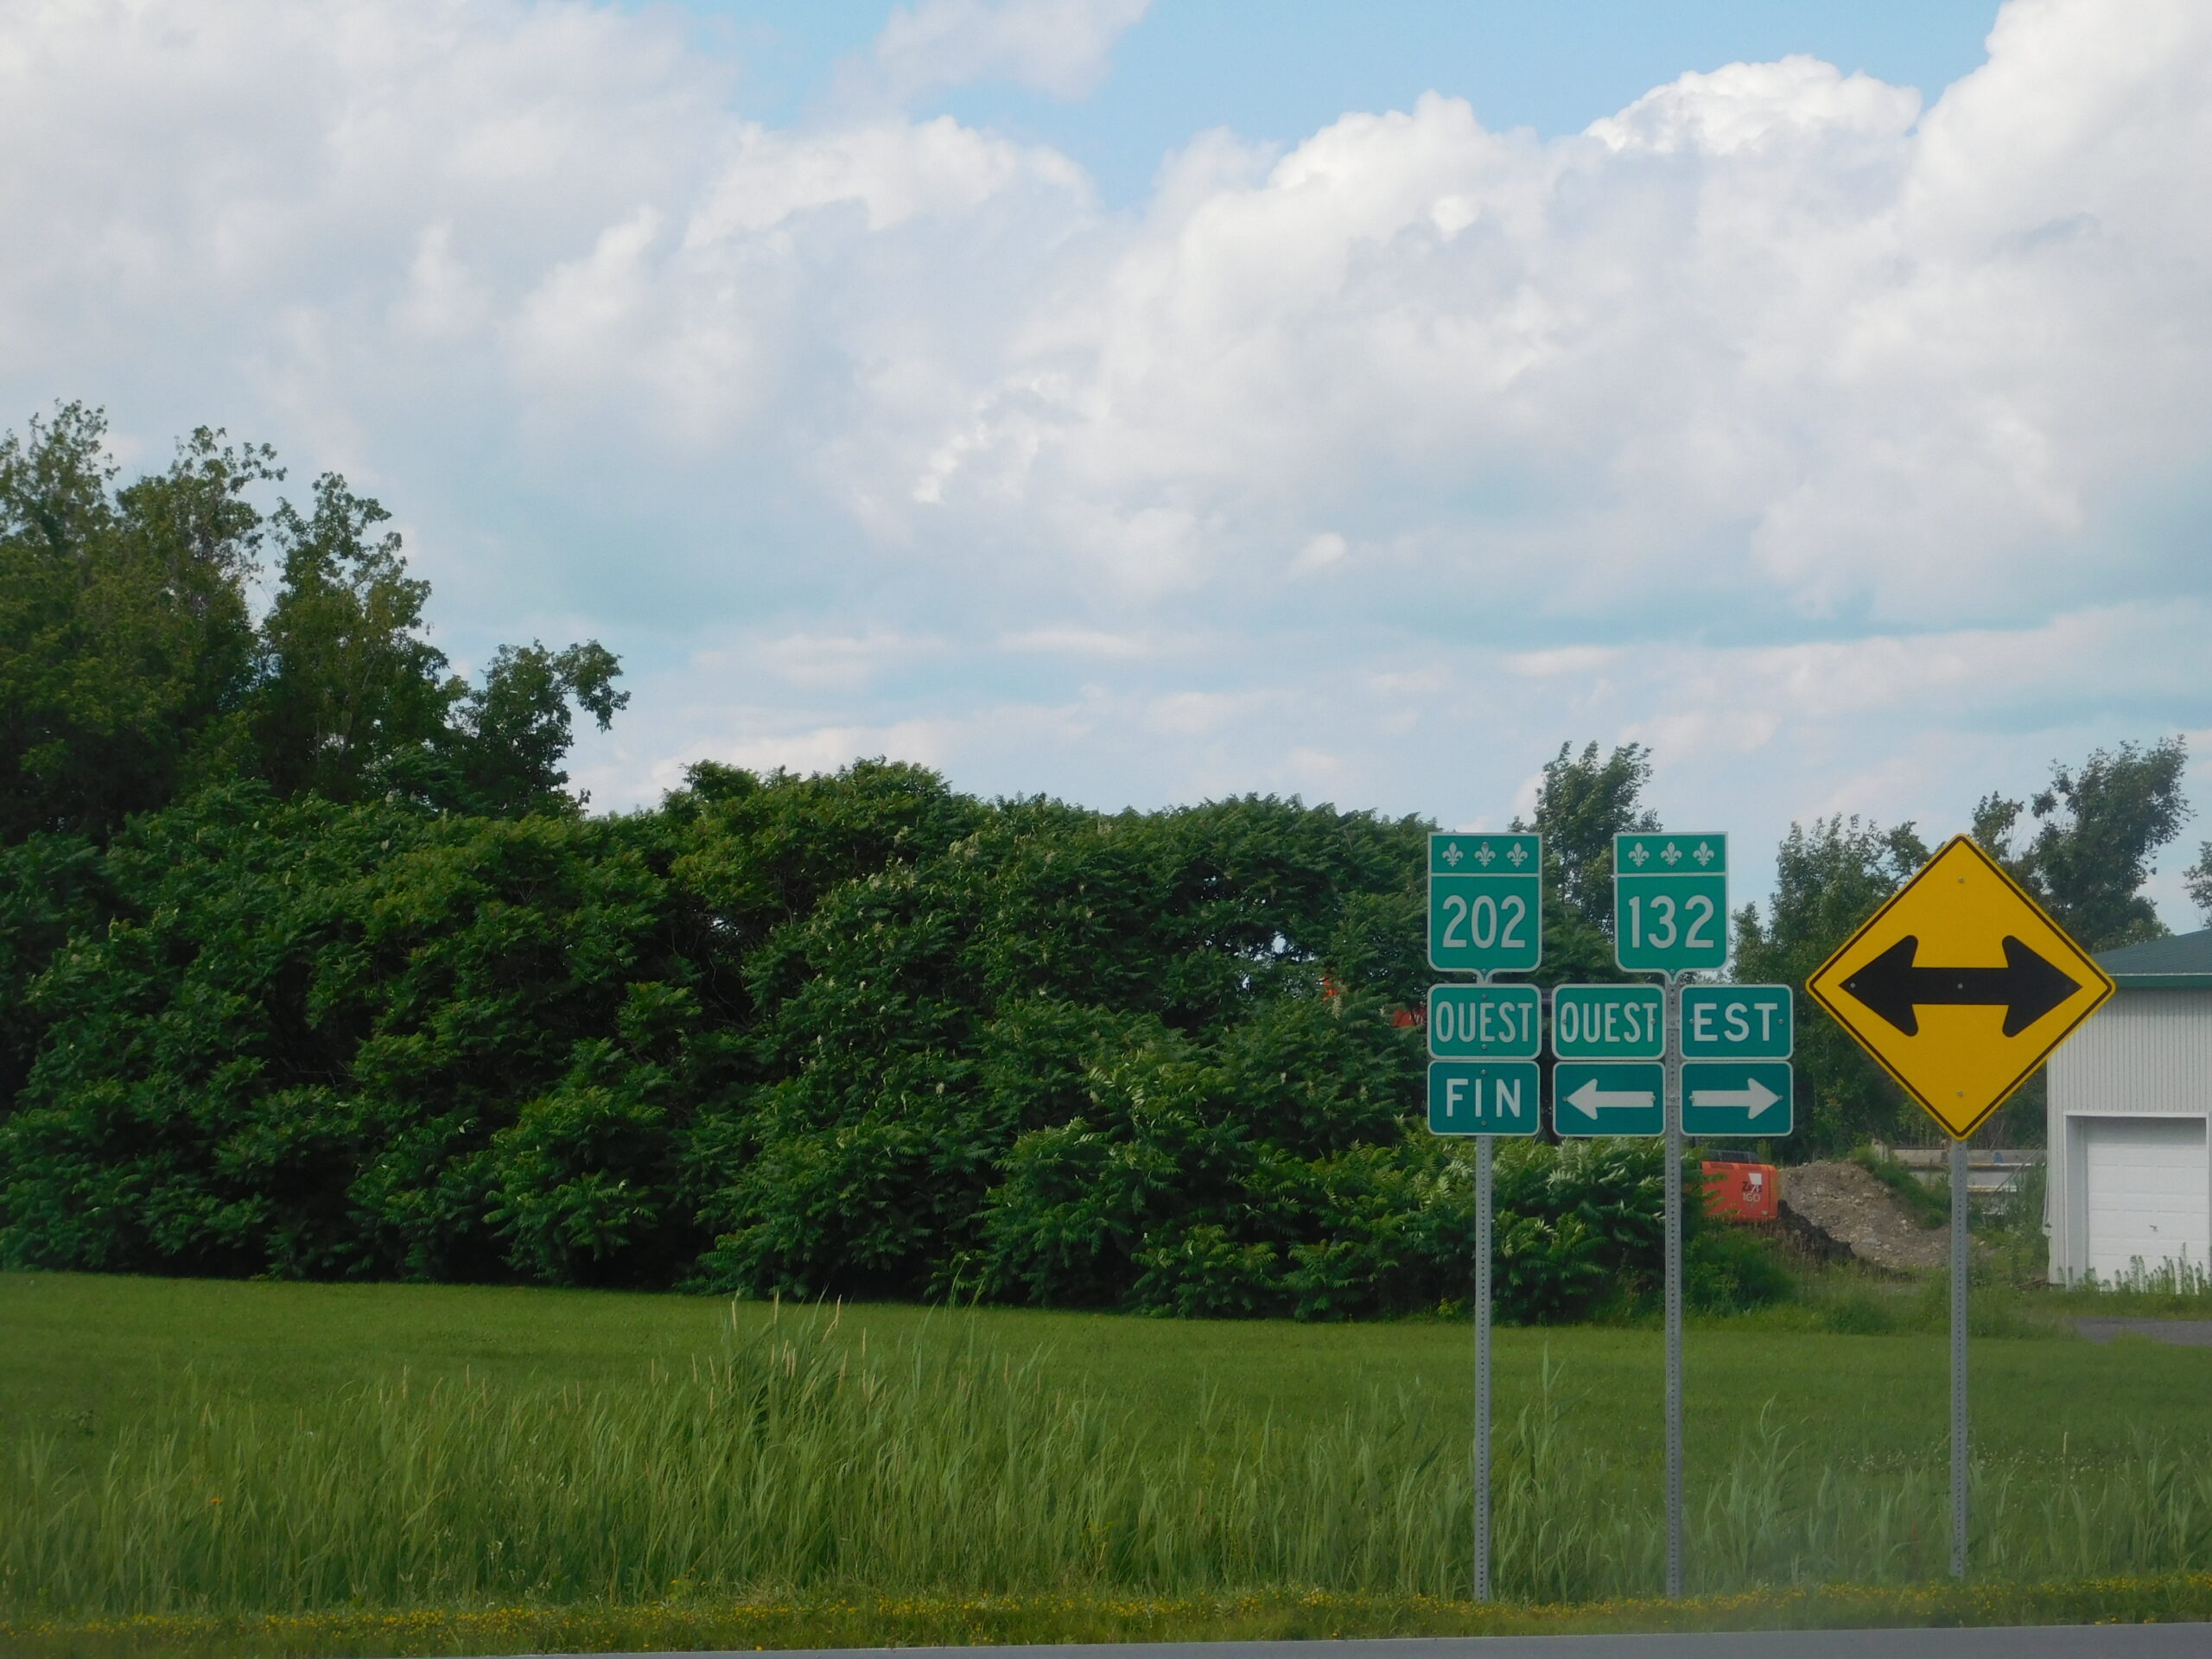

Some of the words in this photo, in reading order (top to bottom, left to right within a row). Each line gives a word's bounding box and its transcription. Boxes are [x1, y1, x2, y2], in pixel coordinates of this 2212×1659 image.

[1442, 894, 1526, 949] 202
[1629, 894, 1713, 949] 132
[1435, 1001, 1533, 1043] OUEST
[1560, 1001, 1658, 1043] OUEST
[1693, 1001, 1778, 1042] EST
[1446, 1077, 1521, 1118] FIN
